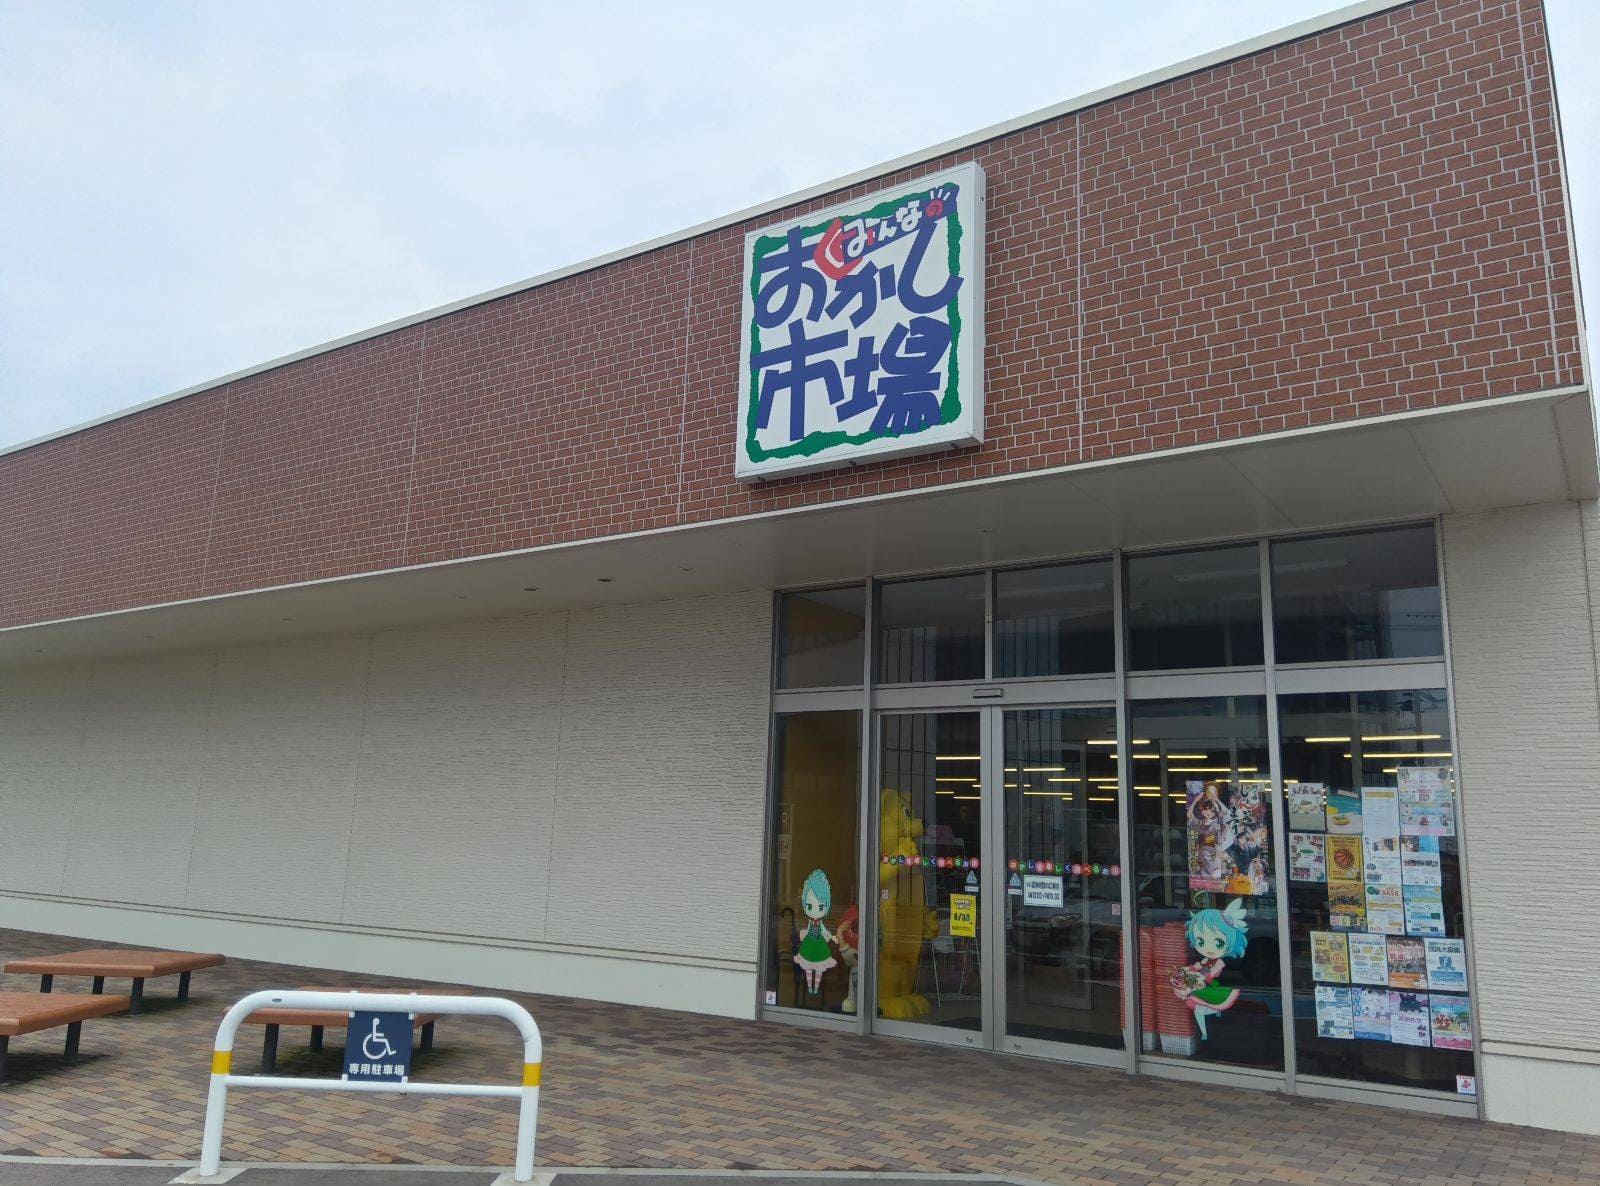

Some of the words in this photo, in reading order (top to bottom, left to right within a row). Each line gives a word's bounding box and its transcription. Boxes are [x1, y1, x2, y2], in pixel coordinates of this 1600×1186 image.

[754, 215, 964, 328] おかし
[843, 197, 944, 259] みんなの
[750, 316, 951, 441] 市場
[348, 1063, 405, 1076] 専用駐車場
